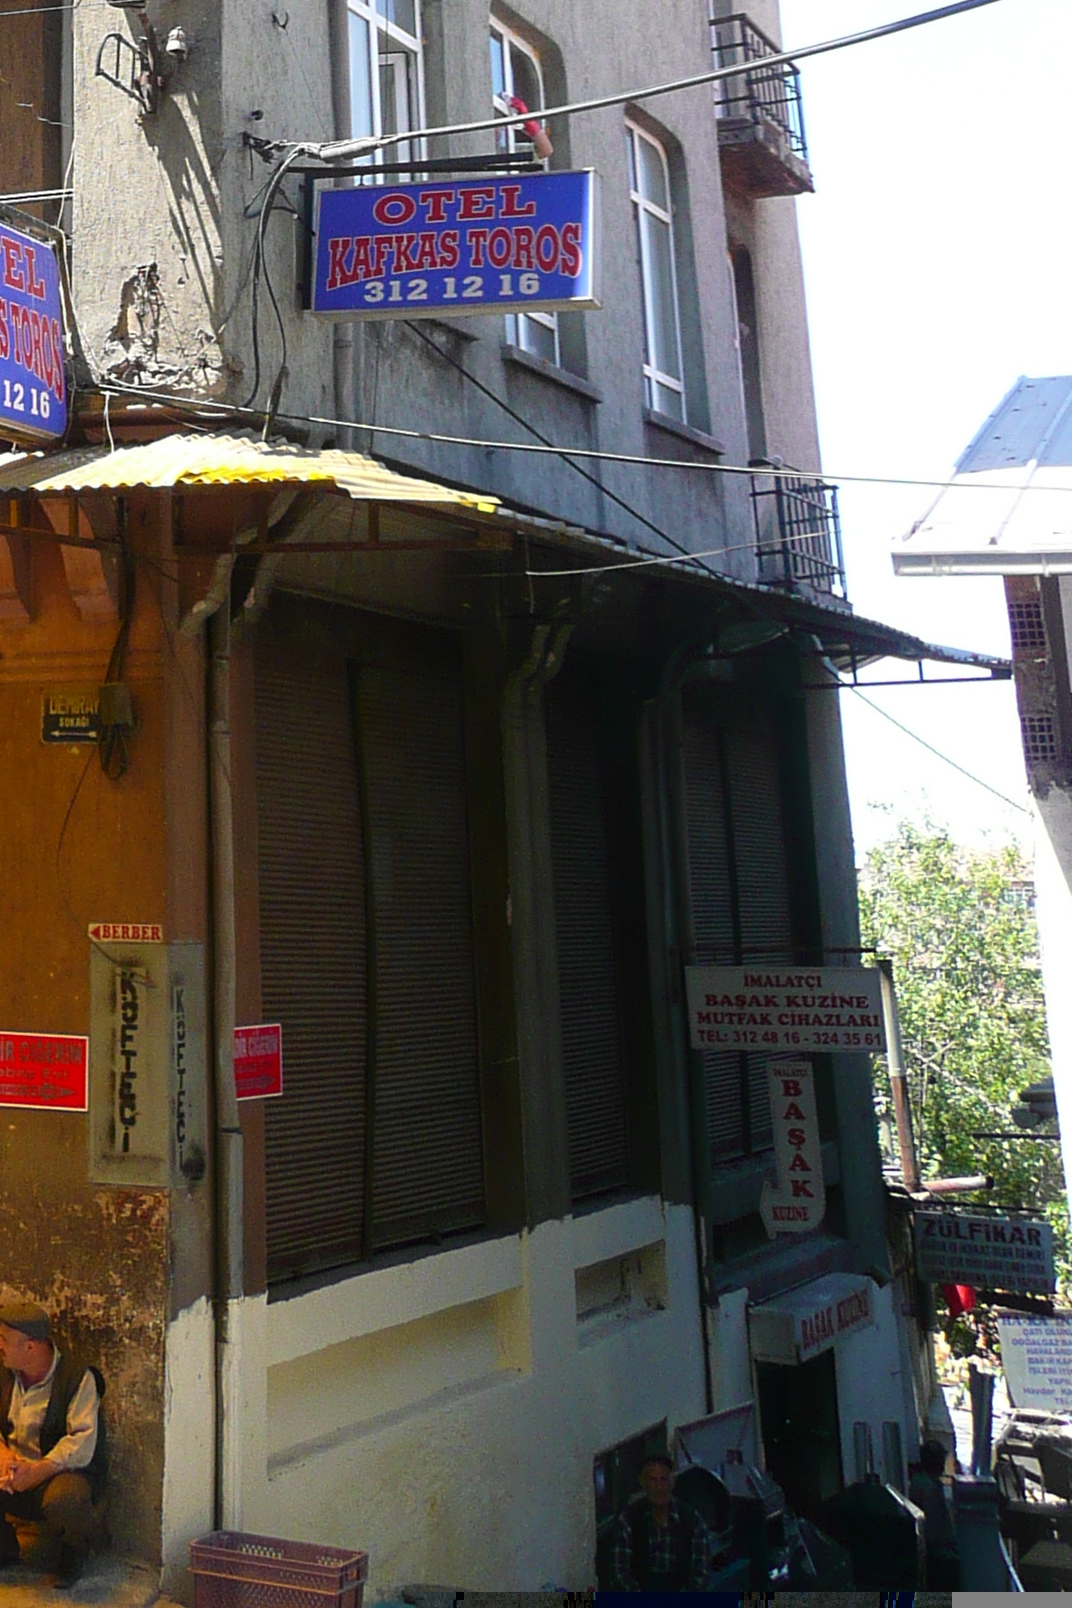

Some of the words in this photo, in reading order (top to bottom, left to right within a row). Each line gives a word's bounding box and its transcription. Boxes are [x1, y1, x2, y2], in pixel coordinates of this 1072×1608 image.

[373, 185, 537, 226] OTEL
[326, 230, 460, 292] KAFKAS
[467, 222, 583, 278] TOROS
[364, 278, 428, 303] 312
[442, 276, 484, 299] 12
[499, 273, 540, 296] 16
[10, 302, 64, 403] TOROS
[3, 380, 25, 411] 12
[30, 388, 50, 418] 16
[102, 924, 160, 940] BERBER
[743, 974, 822, 992] İMALATÇI
[704, 994, 779, 1011] BAŞAK
[785, 992, 870, 1009] KUZİNE
[696, 1011, 773, 1026] MUTFAK
[778, 1011, 879, 1027] CİHAZLARI
[697, 1030, 728, 1042] TEL:
[733, 1030, 758, 1043] 312
[762, 1031, 777, 1043] 48
[783, 1031, 800, 1043] 16
[813, 1032, 838, 1044] 324
[843, 1033, 860, 1045] 35
[865, 1033, 881, 1046] 61
[782, 1079, 815, 1199] BAŞAK
[923, 1219, 1042, 1245] ZÜLFİKAR
